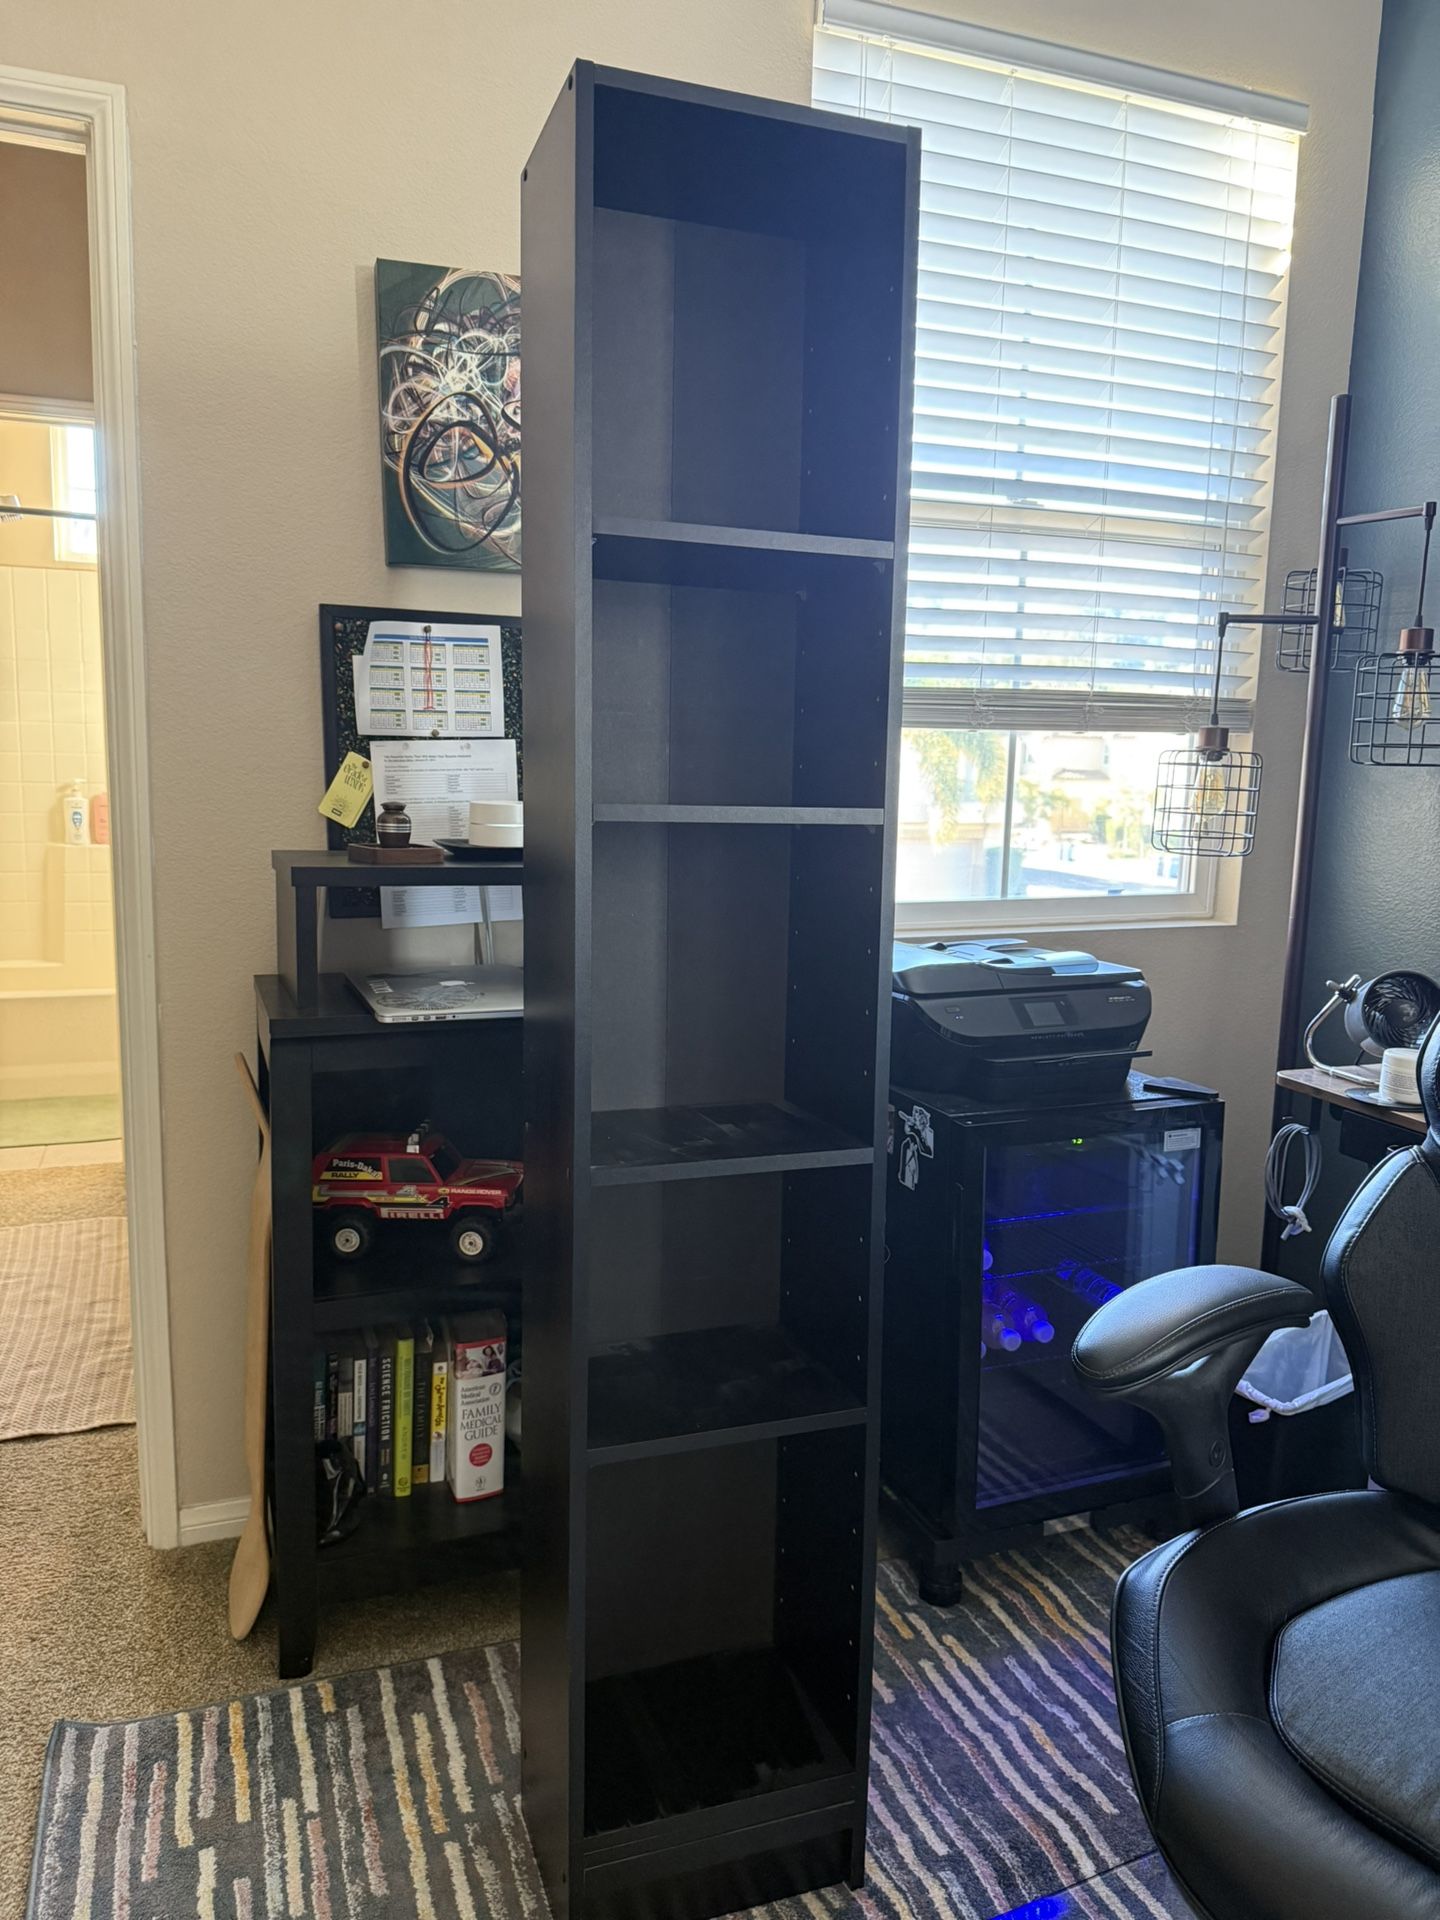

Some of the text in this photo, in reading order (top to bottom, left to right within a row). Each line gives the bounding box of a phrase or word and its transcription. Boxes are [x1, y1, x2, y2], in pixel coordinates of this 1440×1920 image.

[332, 1159, 381, 1178] Paris-Dakar
[380, 1208, 445, 1219] PIRELLI
[381, 1357, 391, 1396] SCIENCE
[462, 1401, 503, 1420] FAMILY
[381, 1400, 391, 1441] FRICTION
[460, 1414, 502, 1431] MEDICAL
[464, 1425, 499, 1441] GUIDE
